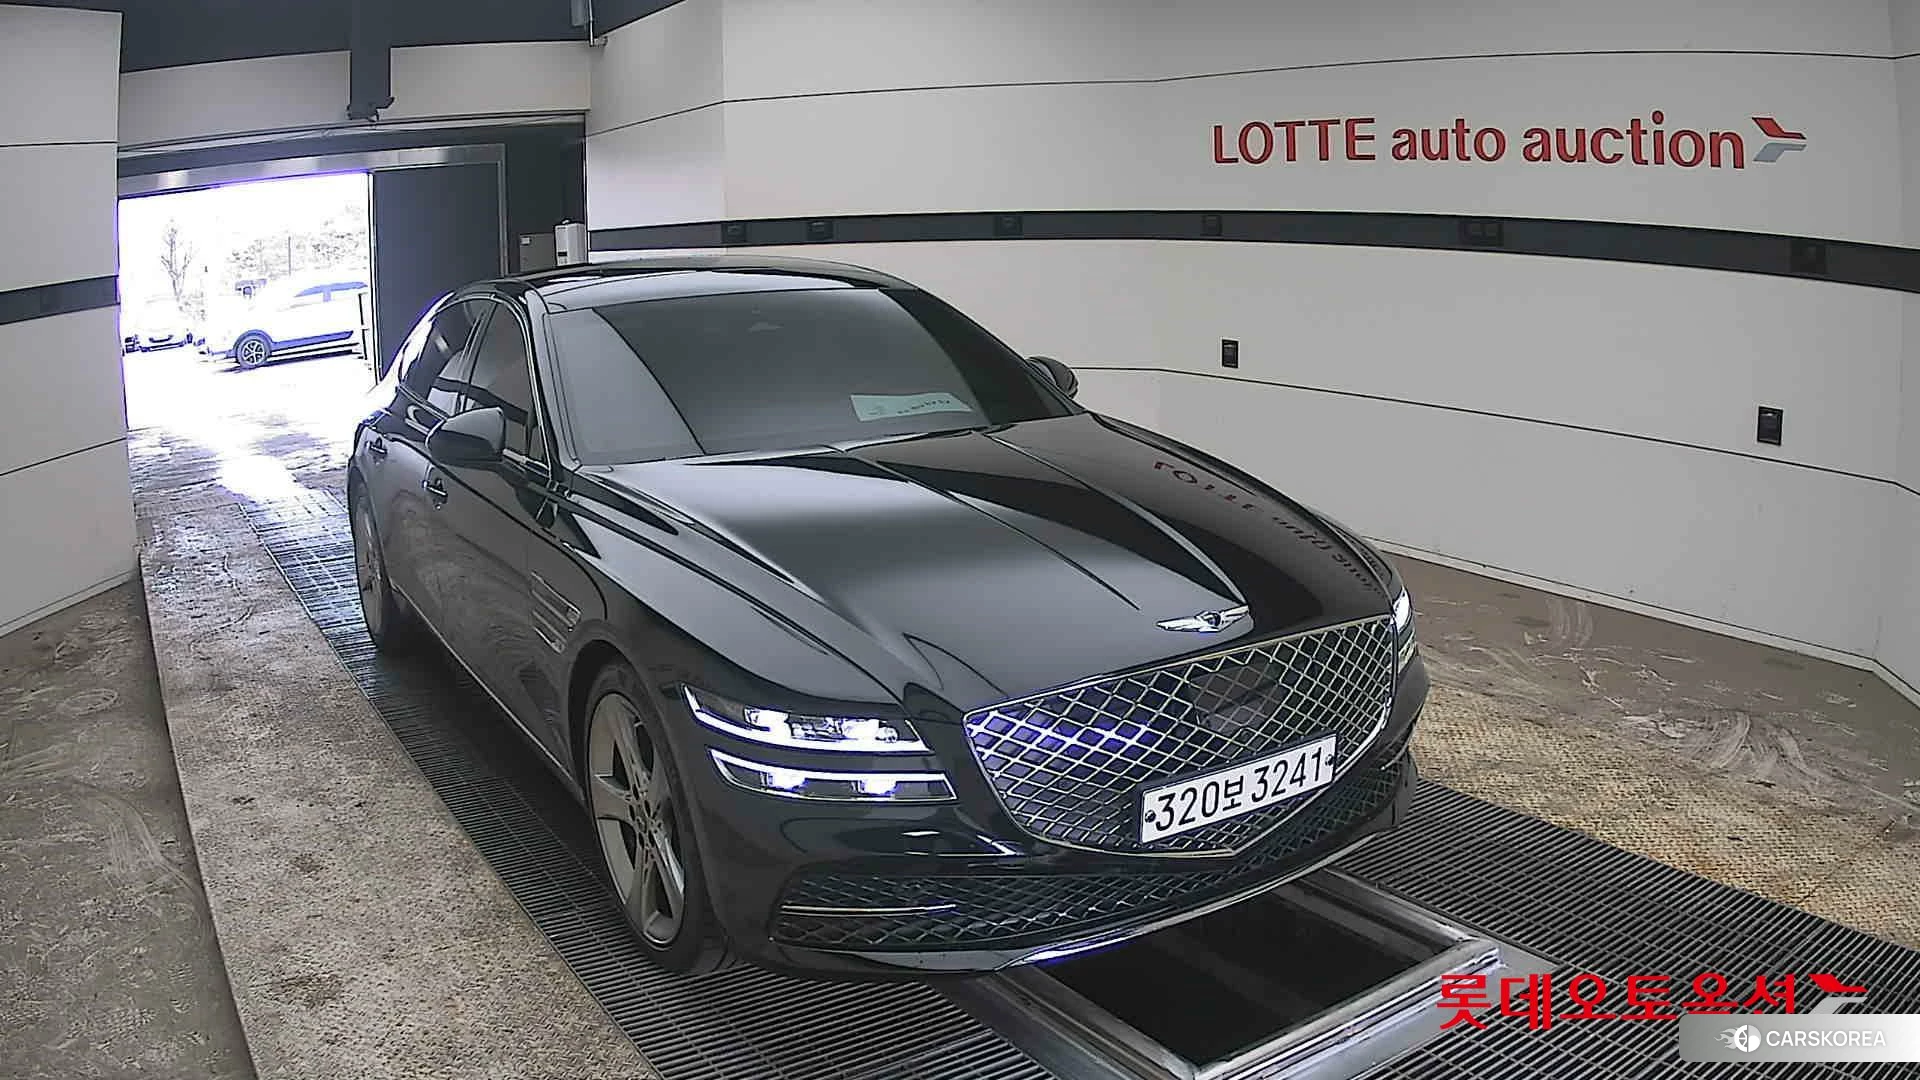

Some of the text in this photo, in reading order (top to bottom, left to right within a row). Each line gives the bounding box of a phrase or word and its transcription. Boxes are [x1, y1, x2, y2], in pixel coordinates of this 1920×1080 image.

[1213, 111, 1745, 169] LOTTE auto auction
[1155, 746, 1322, 832] 320보 3241
